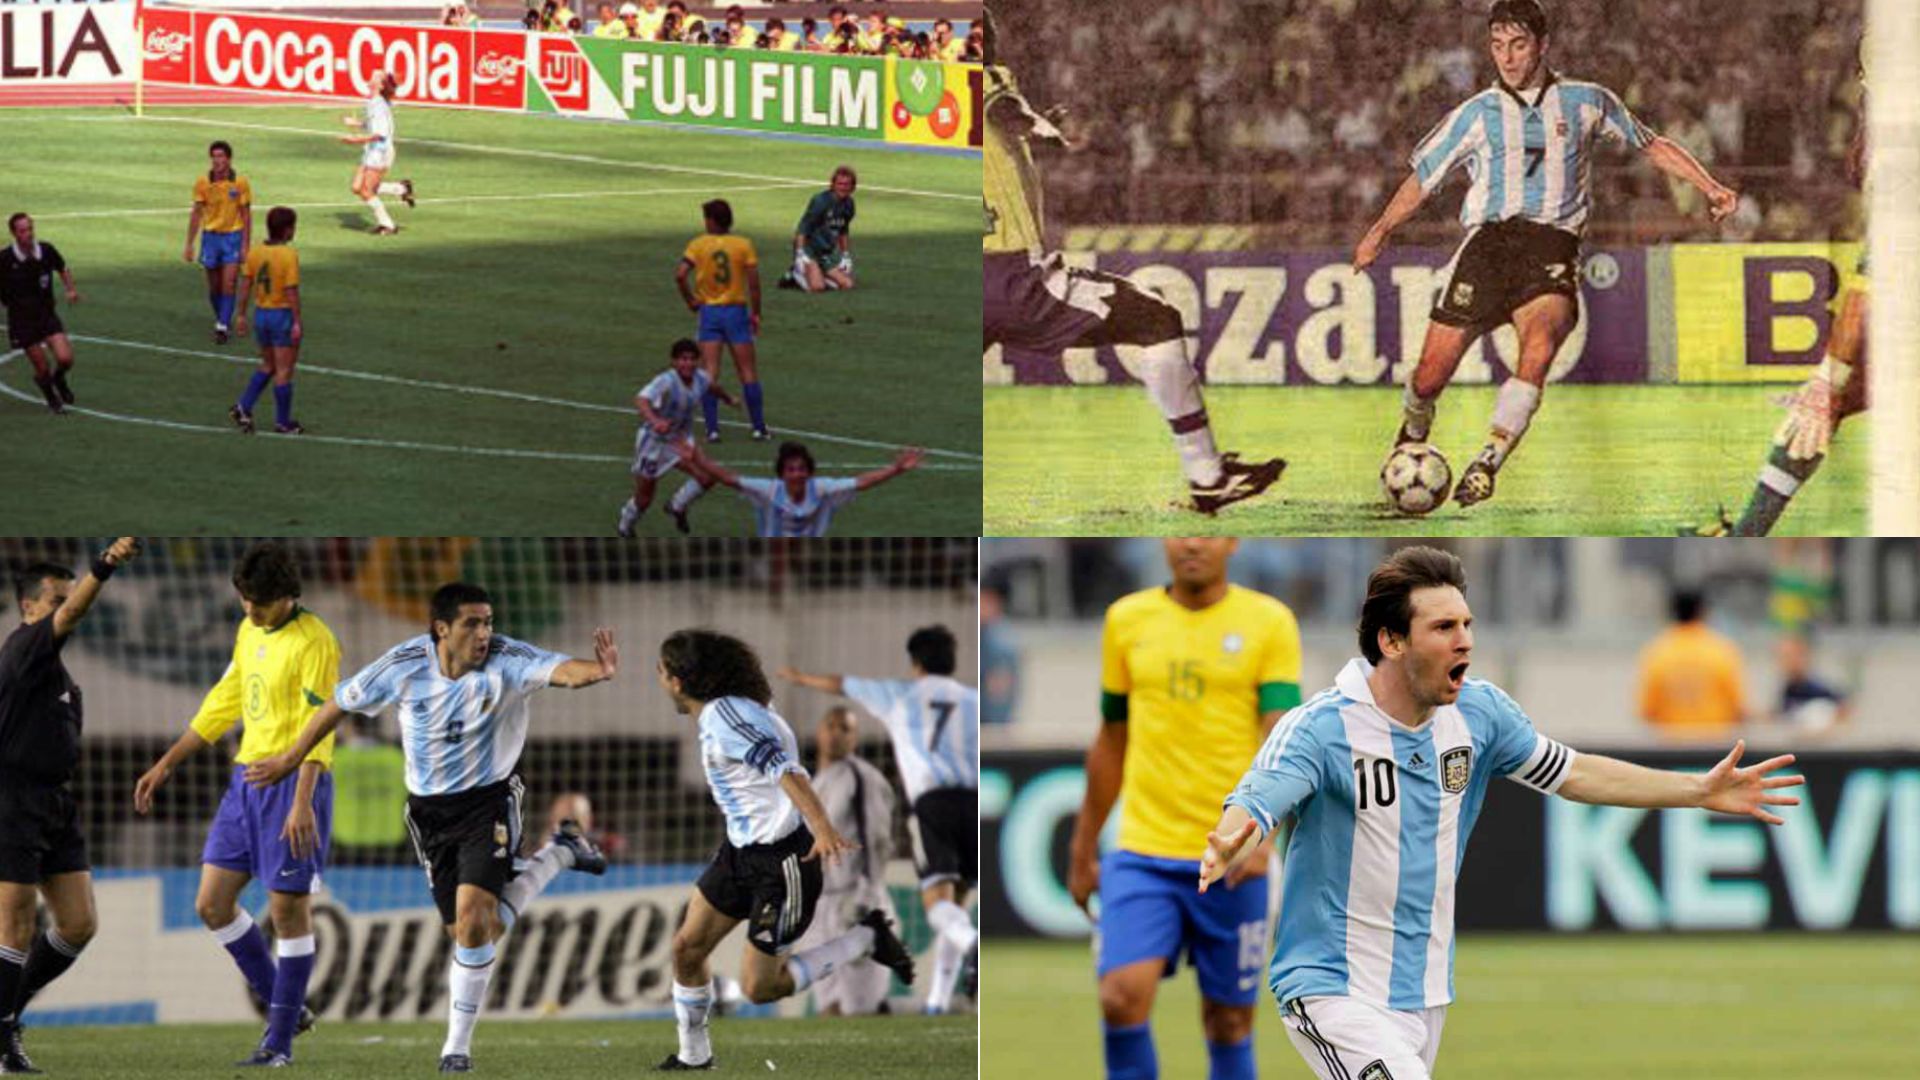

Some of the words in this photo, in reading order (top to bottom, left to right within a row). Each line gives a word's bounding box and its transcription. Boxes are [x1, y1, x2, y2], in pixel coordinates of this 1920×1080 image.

[2, 7, 122, 78] LIA
[205, 17, 459, 101] Coca-Cola
[621, 52, 736, 119] FUJI
[750, 62, 878, 130] FILM
[1523, 146, 1546, 178] 7
[256, 261, 271, 295] 4
[713, 251, 732, 284] 3
[1743, 255, 1840, 366] B
[1166, 659, 1206, 699] 15
[929, 701, 957, 752] 7
[1354, 757, 1397, 810] 10
